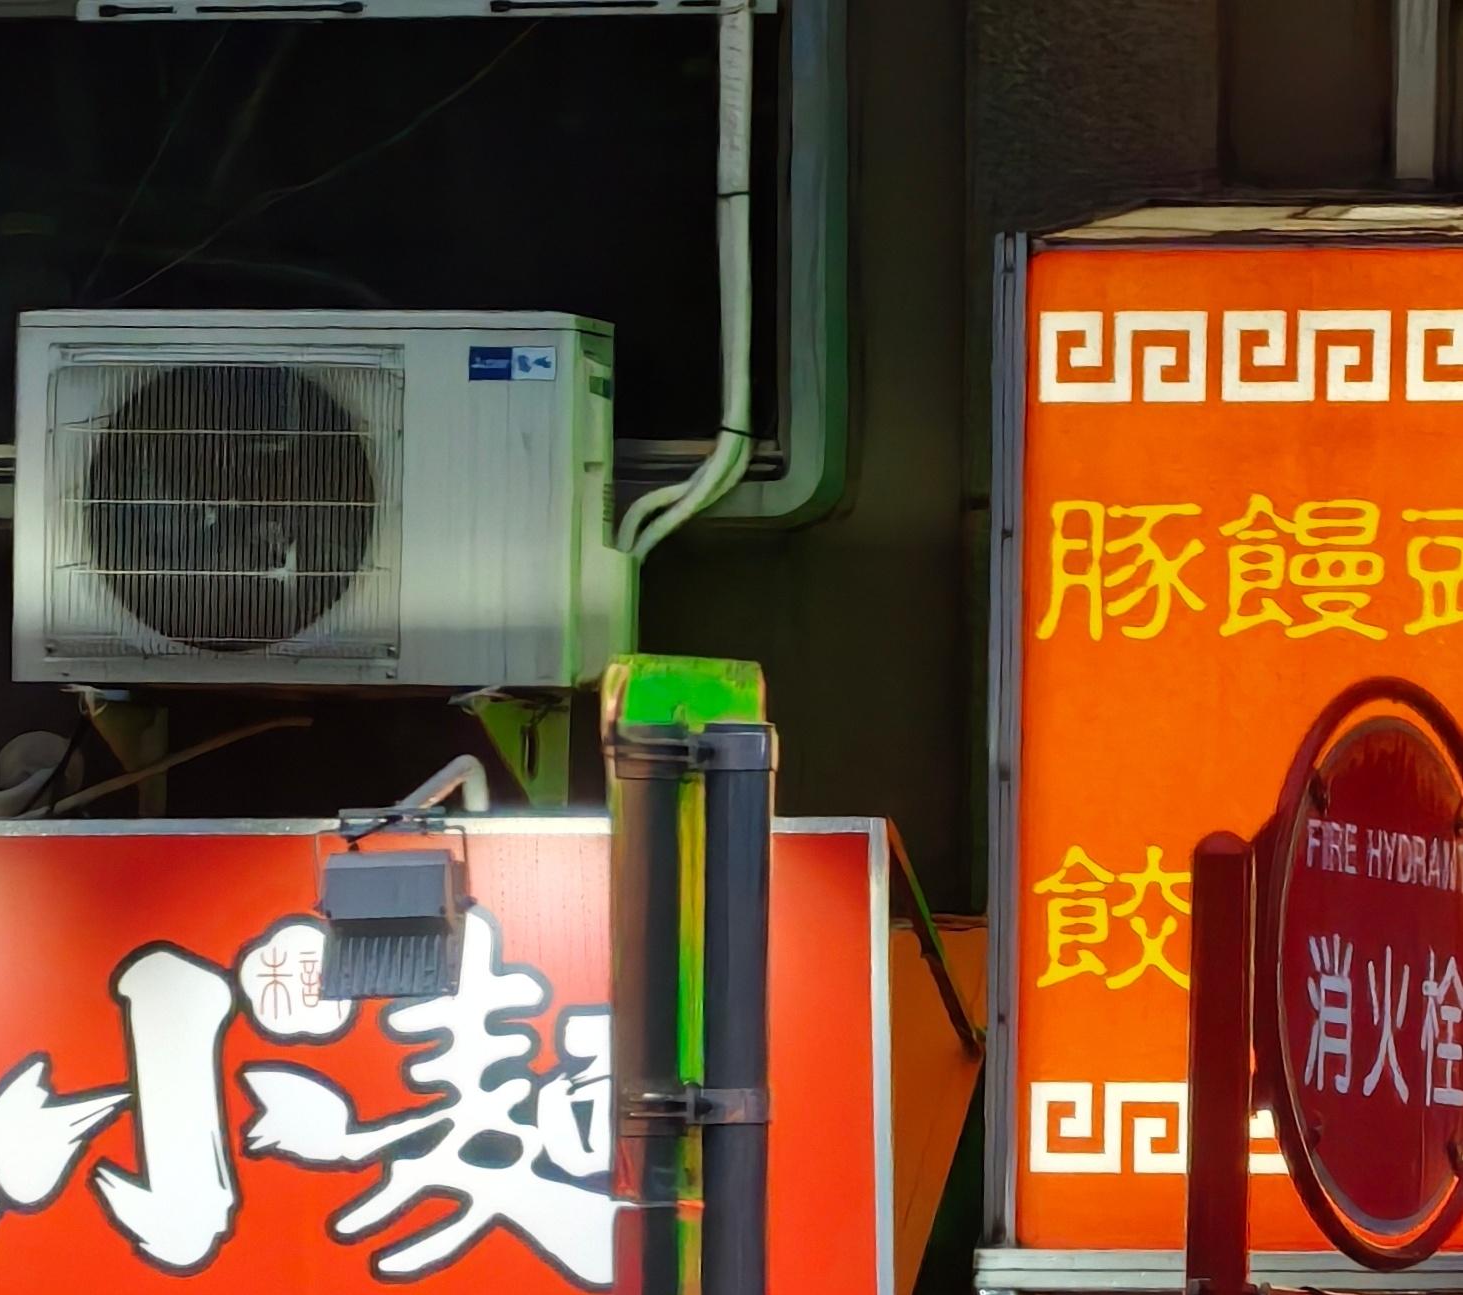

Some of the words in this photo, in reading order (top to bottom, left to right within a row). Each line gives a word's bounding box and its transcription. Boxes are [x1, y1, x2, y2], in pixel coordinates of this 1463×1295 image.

[1306, 819, 1358, 874] FIRE
[1367, 829, 1463, 893] HYDRAN
[1304, 934, 1463, 1107] 消火栓
